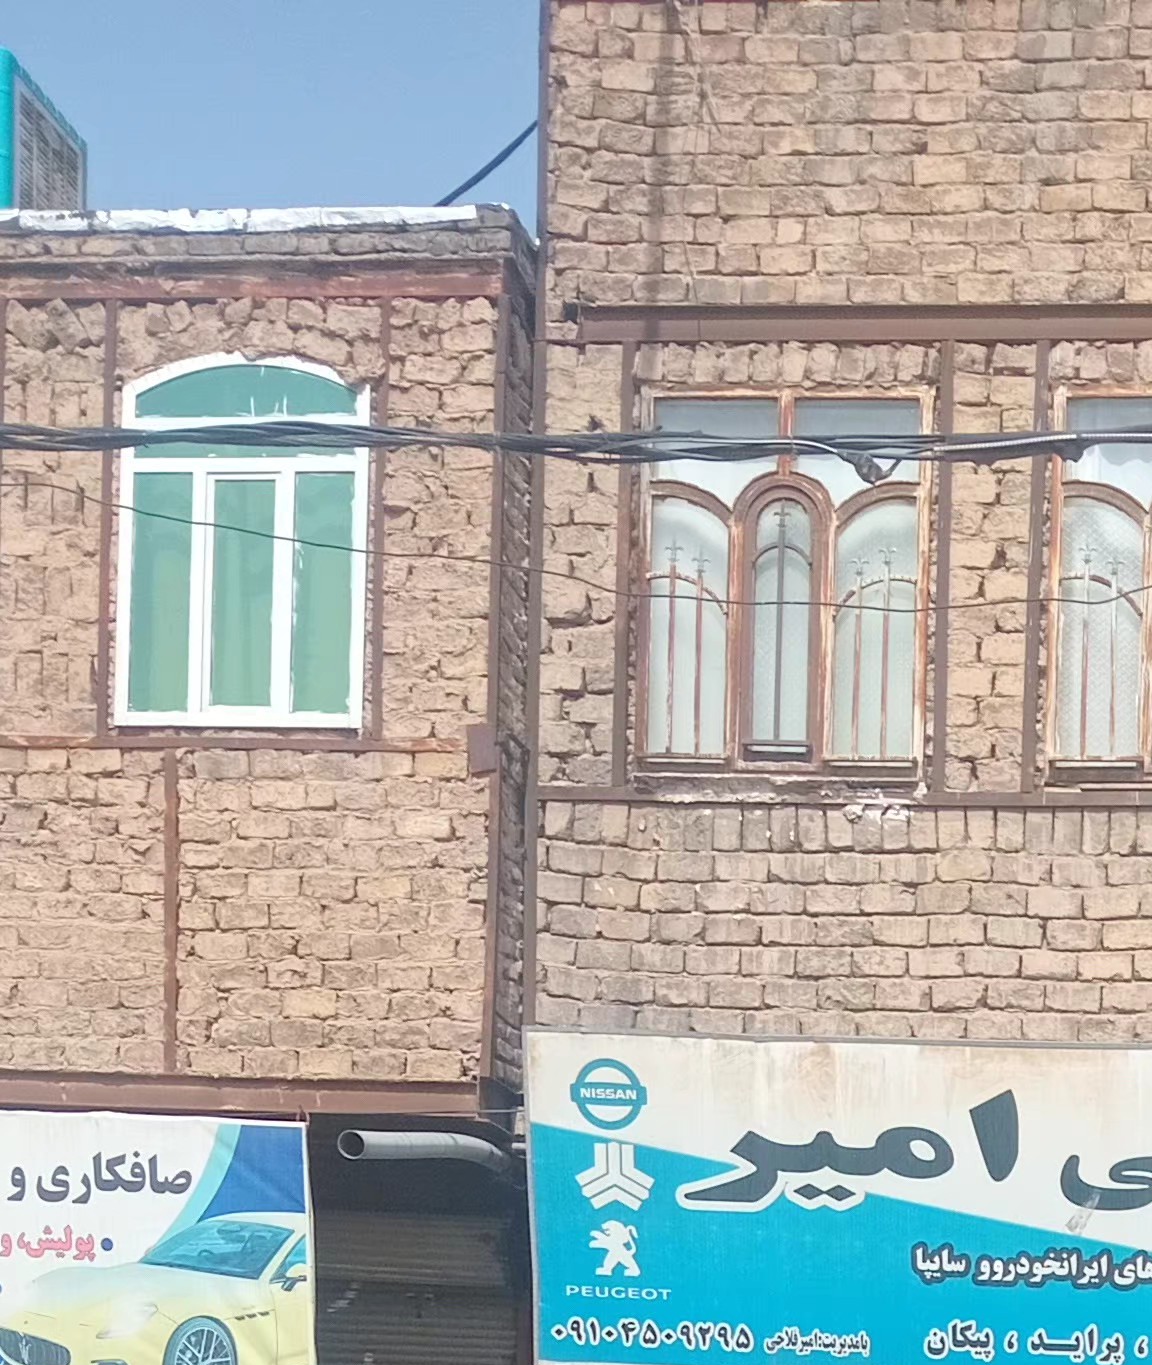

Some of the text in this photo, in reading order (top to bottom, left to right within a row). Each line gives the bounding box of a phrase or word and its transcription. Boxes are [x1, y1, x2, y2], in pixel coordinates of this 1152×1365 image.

[579, 1087, 637, 1100] NISSAN
[680, 1088, 1019, 1206] امیر
[7, 1151, 192, 1204] صافکاری و
[915, 1247, 967, 1279] سایپا
[565, 1284, 672, 1301] PEUGEOT
[552, 1316, 754, 1351] ۰۹۱۰۴۵۰۹۲۹۵
[924, 1320, 995, 1360] پیکان
